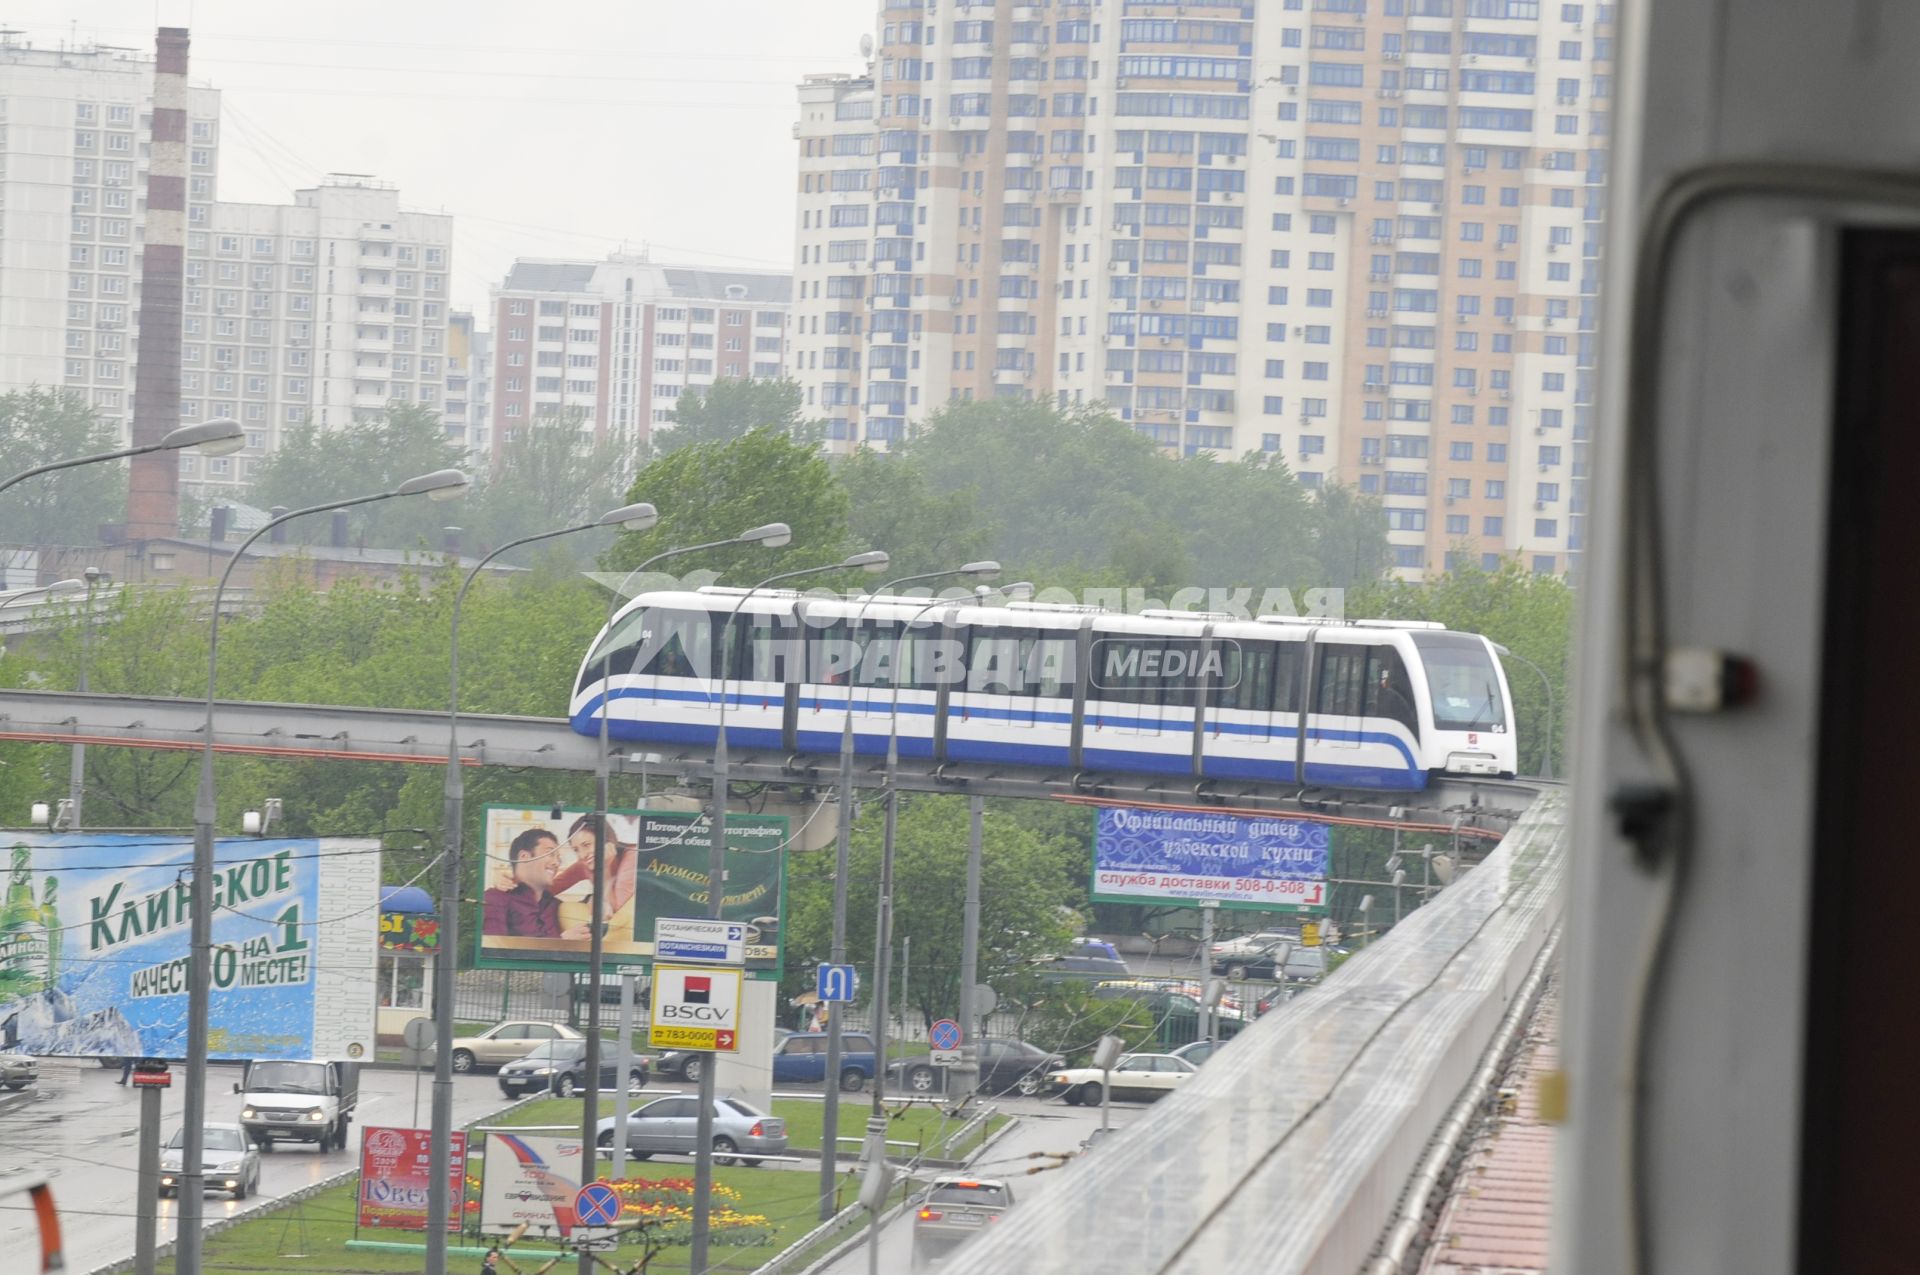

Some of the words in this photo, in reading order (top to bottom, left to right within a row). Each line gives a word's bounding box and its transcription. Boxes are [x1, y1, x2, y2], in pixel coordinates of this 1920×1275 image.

[646, 821, 689, 833] Потому
[690, 825, 710, 834] что
[1113, 809, 1237, 834] Официальный
[1249, 818, 1299, 839] дилер
[1163, 838, 1249, 859] узбекской
[1261, 846, 1314, 863] кухни
[1100, 873, 1156, 889] служба
[1160, 875, 1231, 891] доставки
[1235, 878, 1305, 895] 508-0-508
[243, 936, 271, 958] НА
[276, 904, 308, 953] 1
[660, 923, 723, 933] БОТАНИЧЕСКАЯ
[132, 944, 237, 997] КАЧЕСТО
[241, 954, 308, 986] МЕСТЕ!
[662, 1004, 730, 1020] BSGV
[666, 1030, 715, 1041] 783-0000
